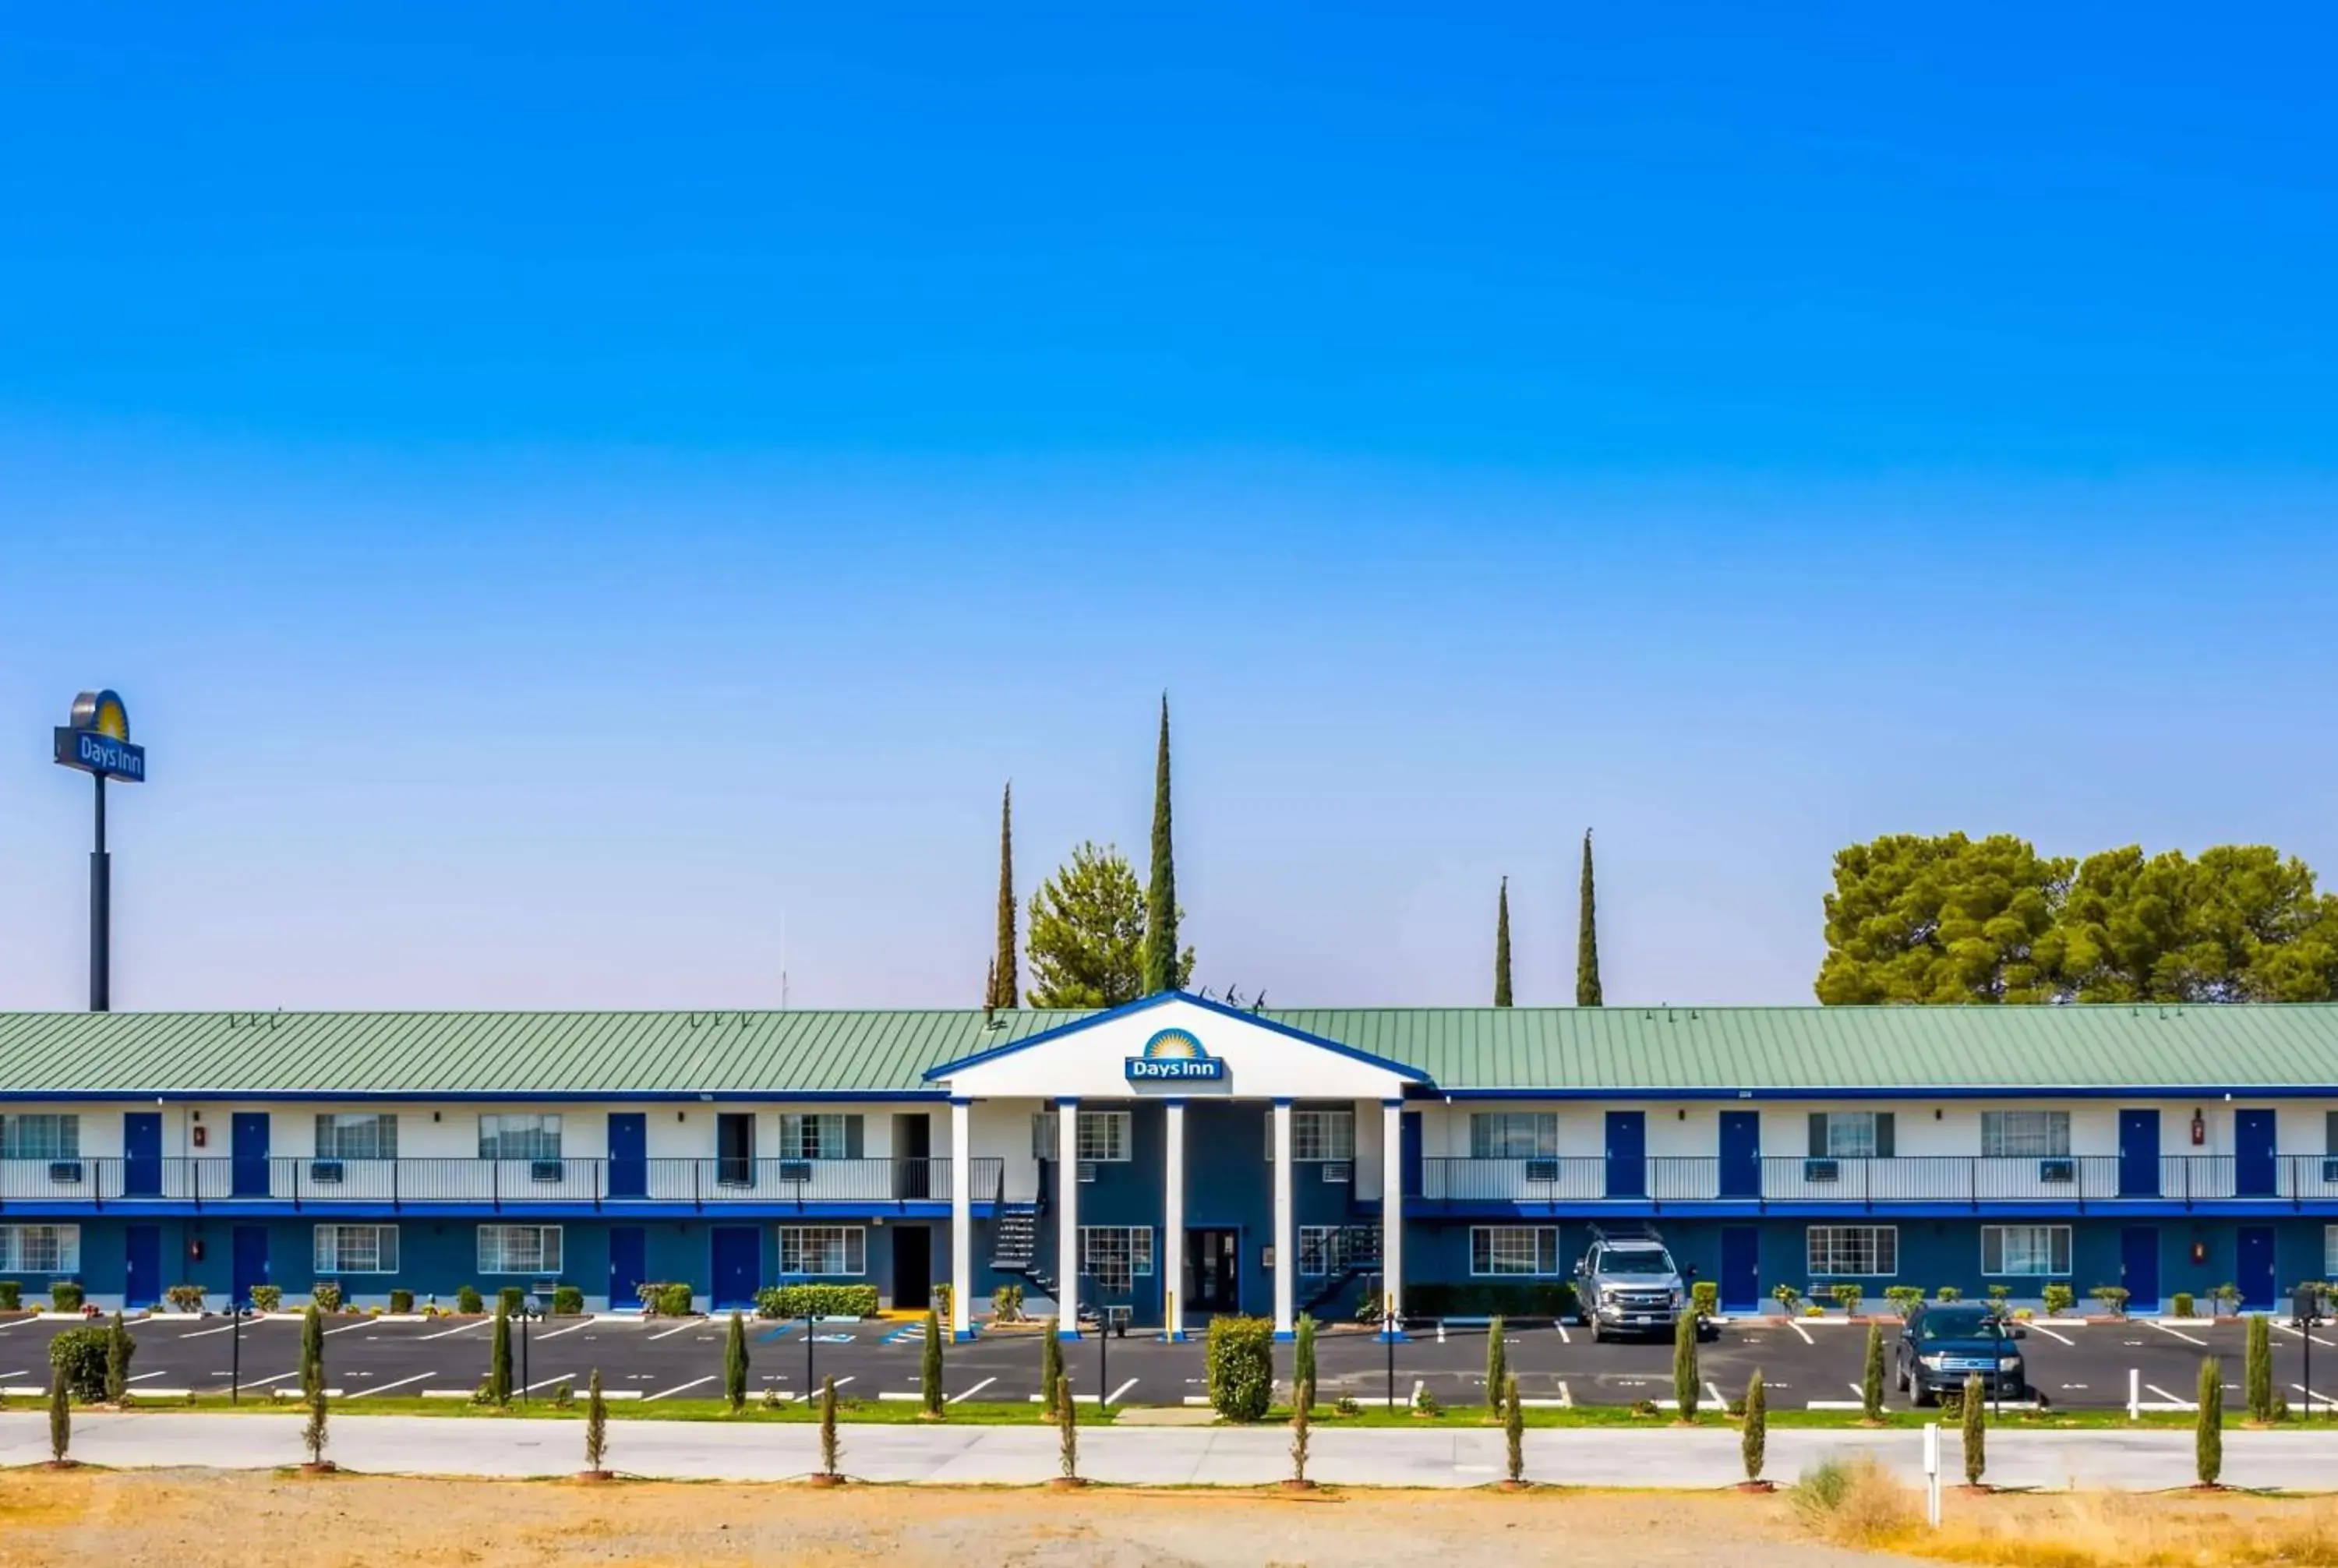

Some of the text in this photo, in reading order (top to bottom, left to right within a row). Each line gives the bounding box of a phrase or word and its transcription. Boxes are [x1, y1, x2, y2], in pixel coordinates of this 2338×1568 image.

[81, 735, 142, 774] Days Inn
[1133, 1061, 1214, 1078] Days Inn
